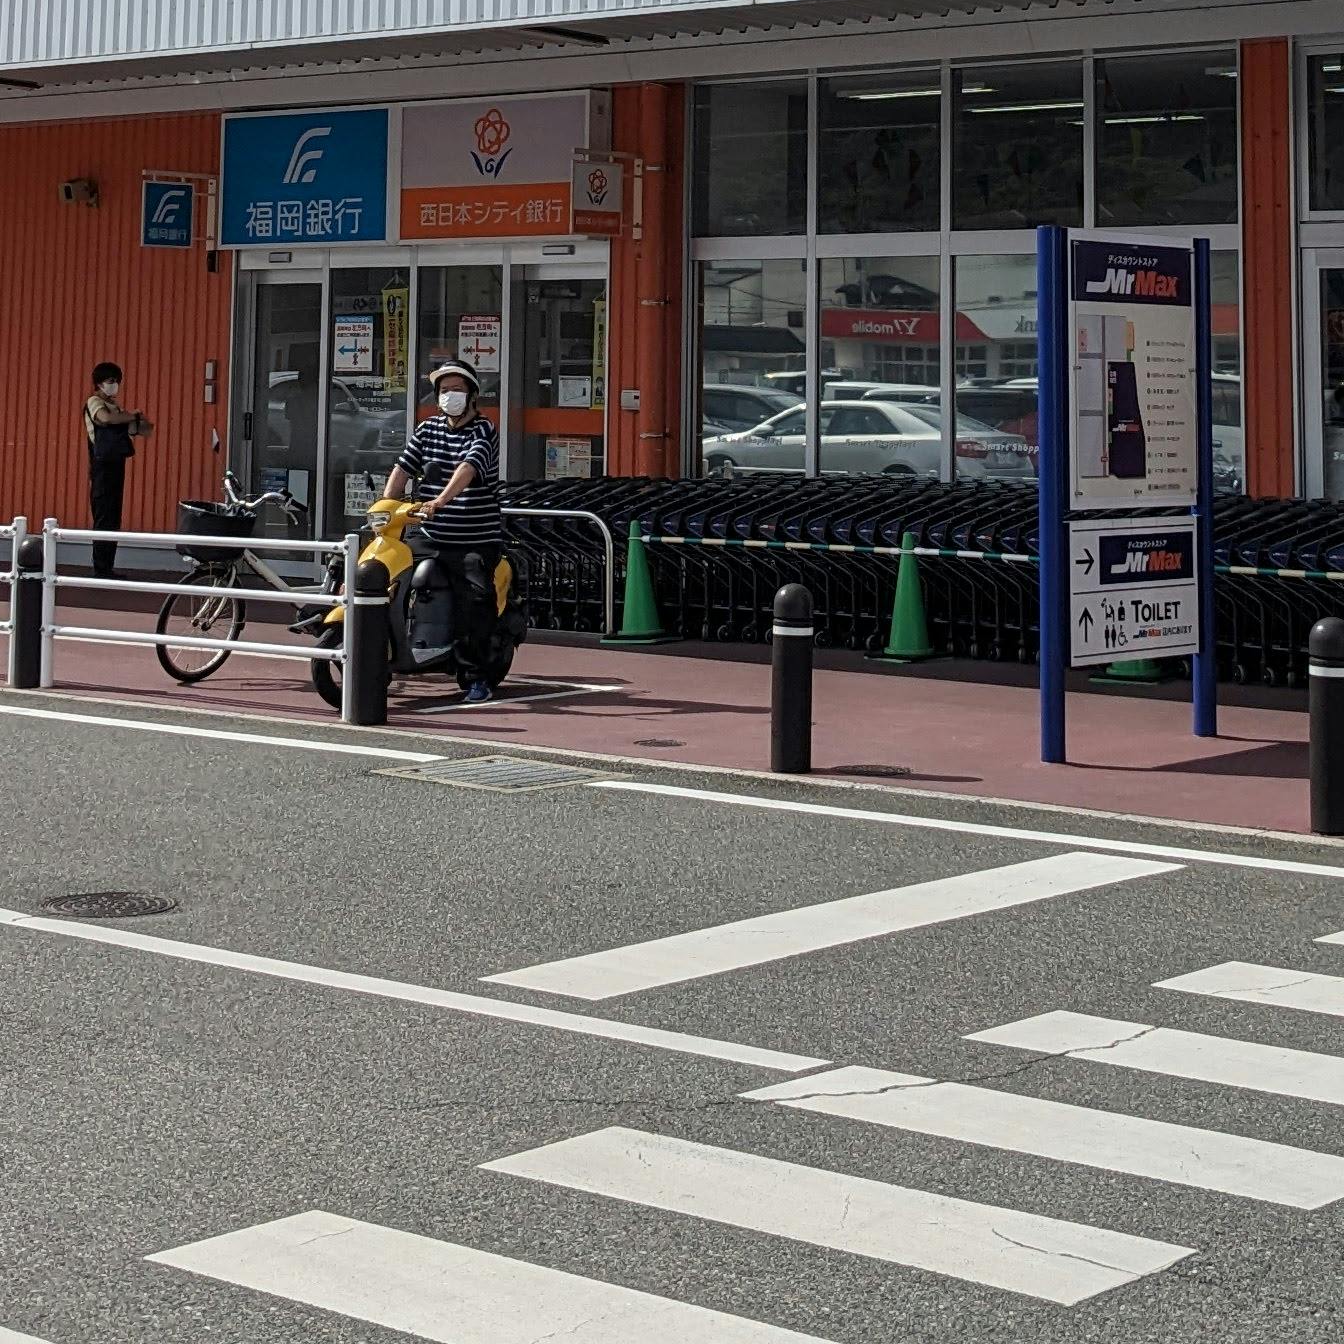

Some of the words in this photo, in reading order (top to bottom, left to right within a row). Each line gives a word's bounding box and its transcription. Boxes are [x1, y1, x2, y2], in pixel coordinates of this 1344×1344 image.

[246, 197, 363, 237] 福岡銀行
[420, 199, 564, 226] 西日本シティ銀行
[1086, 268, 1178, 298] MrMax
[1110, 550, 1182, 574] MrMax
[1131, 600, 1181, 623] TOILET
